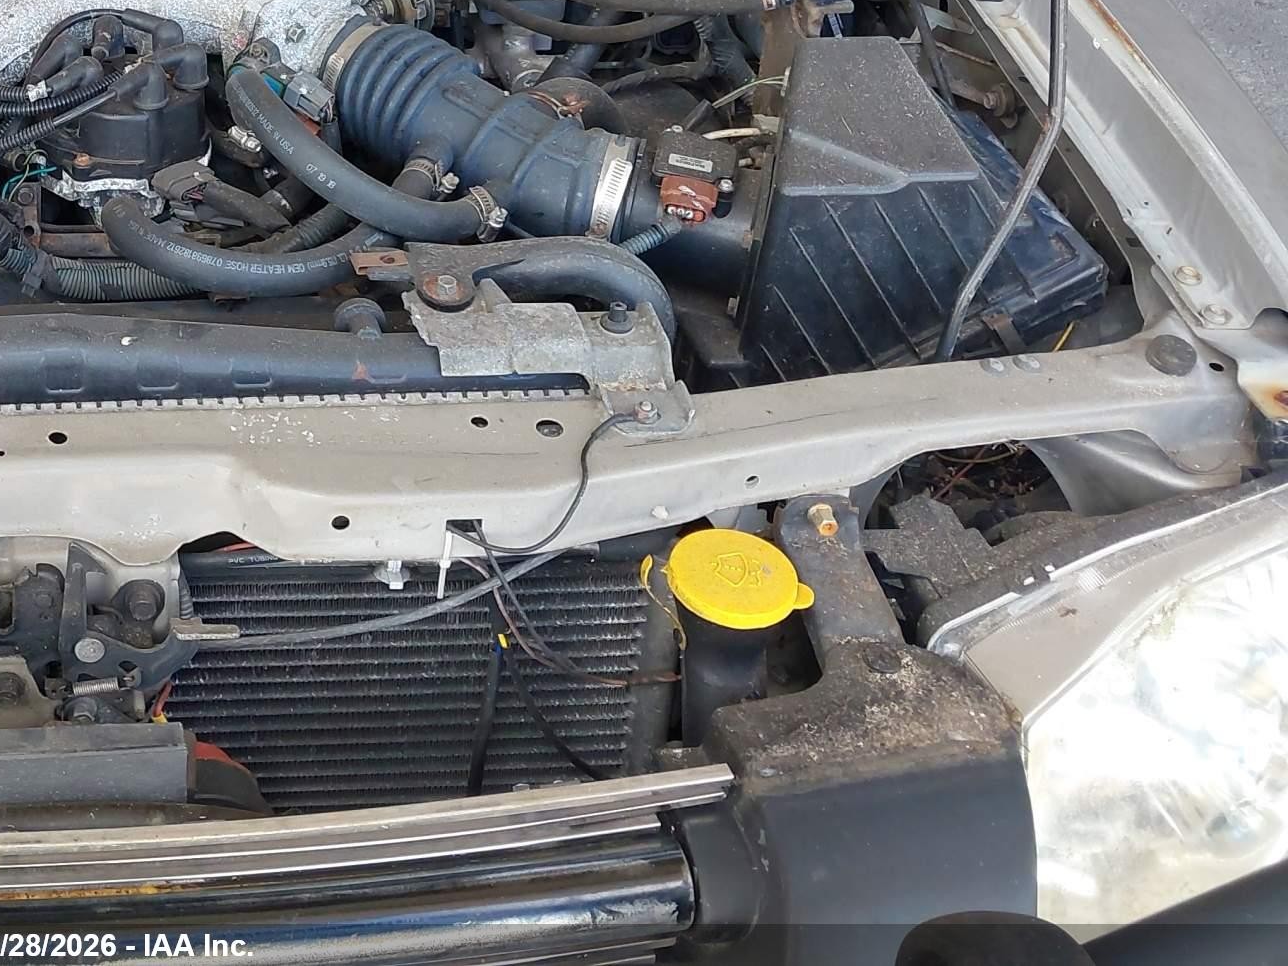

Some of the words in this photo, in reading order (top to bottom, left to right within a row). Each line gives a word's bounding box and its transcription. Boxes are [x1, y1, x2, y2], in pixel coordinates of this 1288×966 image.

[279, 138, 295, 154] USA
[224, 260, 249, 272] HOSE
[250, 263, 286, 274] HEATER
[287, 263, 305, 274] OEM
